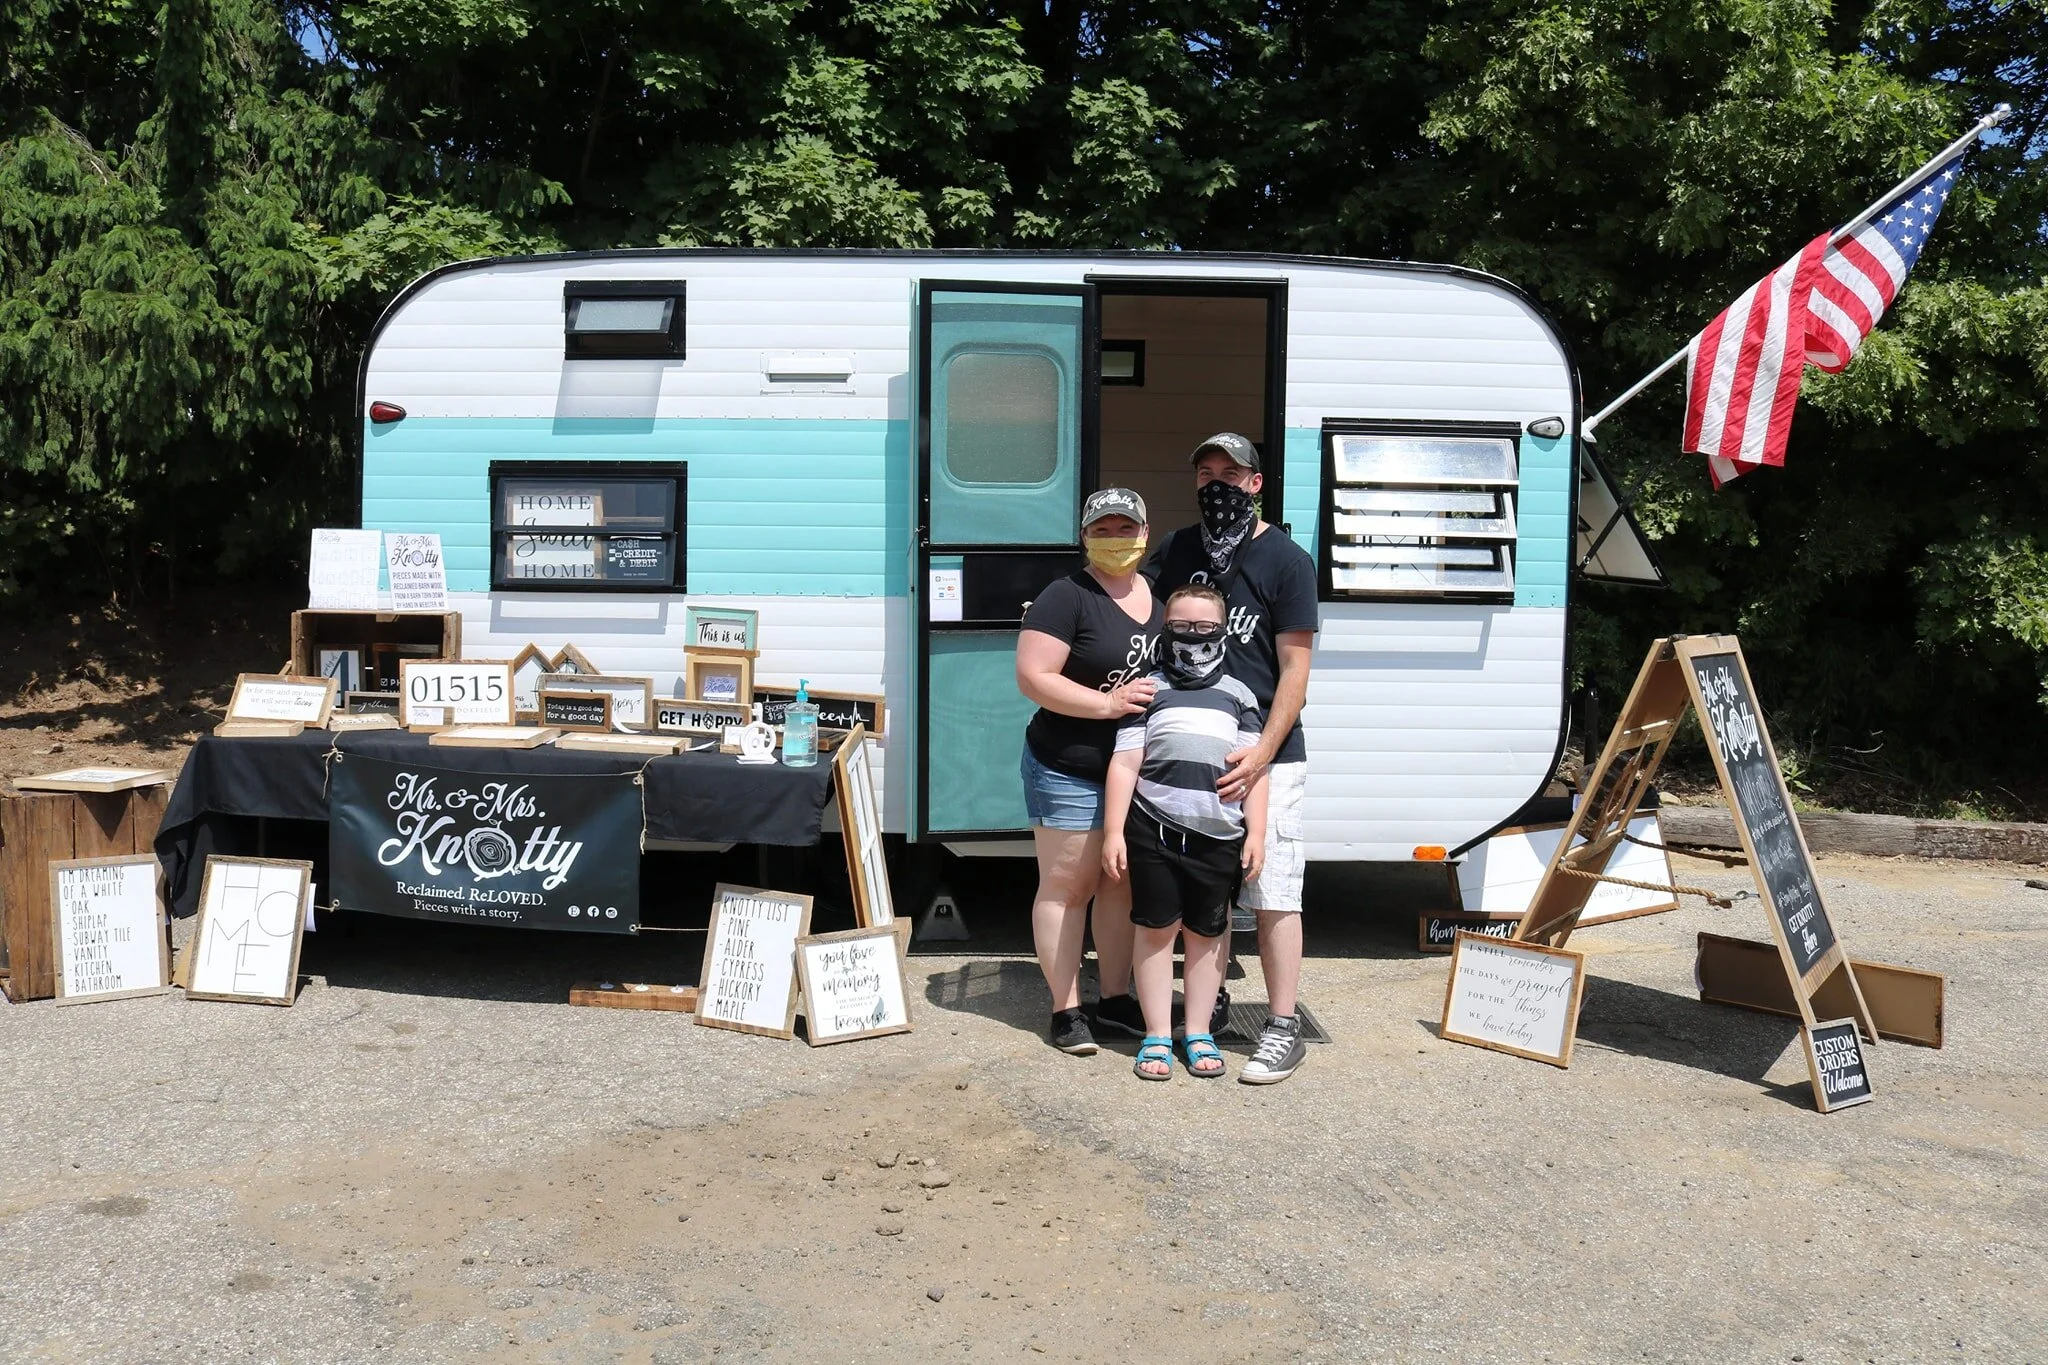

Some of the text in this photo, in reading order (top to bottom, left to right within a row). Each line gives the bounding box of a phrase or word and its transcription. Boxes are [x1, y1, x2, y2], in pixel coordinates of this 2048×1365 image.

[520, 495, 591, 510] HOME
[390, 548, 439, 568] Knotty
[619, 558, 658, 568] & DEBIT
[623, 549, 657, 558] CREDIT
[393, 571, 442, 580] PIECES MADE WITH
[524, 563, 594, 578] HOME
[699, 623, 746, 644] This is us
[411, 675, 503, 702] 01515
[547, 703, 565, 711] Today
[547, 711, 560, 719] for
[567, 713, 588, 721] good
[589, 714, 604, 723] day
[660, 710, 685, 726] GET
[1711, 702, 1762, 762] Knotty
[387, 772, 546, 822] Mr. & Mrs.
[377, 810, 584, 891] Knotty
[79, 866, 125, 883] DREAMING
[63, 881, 122, 900] OF A WHITE
[396, 881, 547, 906] Reclaimed. ReLOVED.
[413, 898, 523, 920] Pieces with a story.
[722, 896, 790, 922] KNOTTY LIST
[114, 926, 131, 942] TILE
[1469, 944, 1554, 974] I STILL remember
[1459, 966, 1573, 1001] THE DAYS we prayed
[1467, 991, 1546, 1022] FOR THE things
[1469, 1010, 1535, 1046] WE have today
[1813, 1034, 1856, 1056] CUSTOM
[1817, 1048, 1860, 1073] ORDERS
[1821, 1068, 1864, 1094] Welcome
